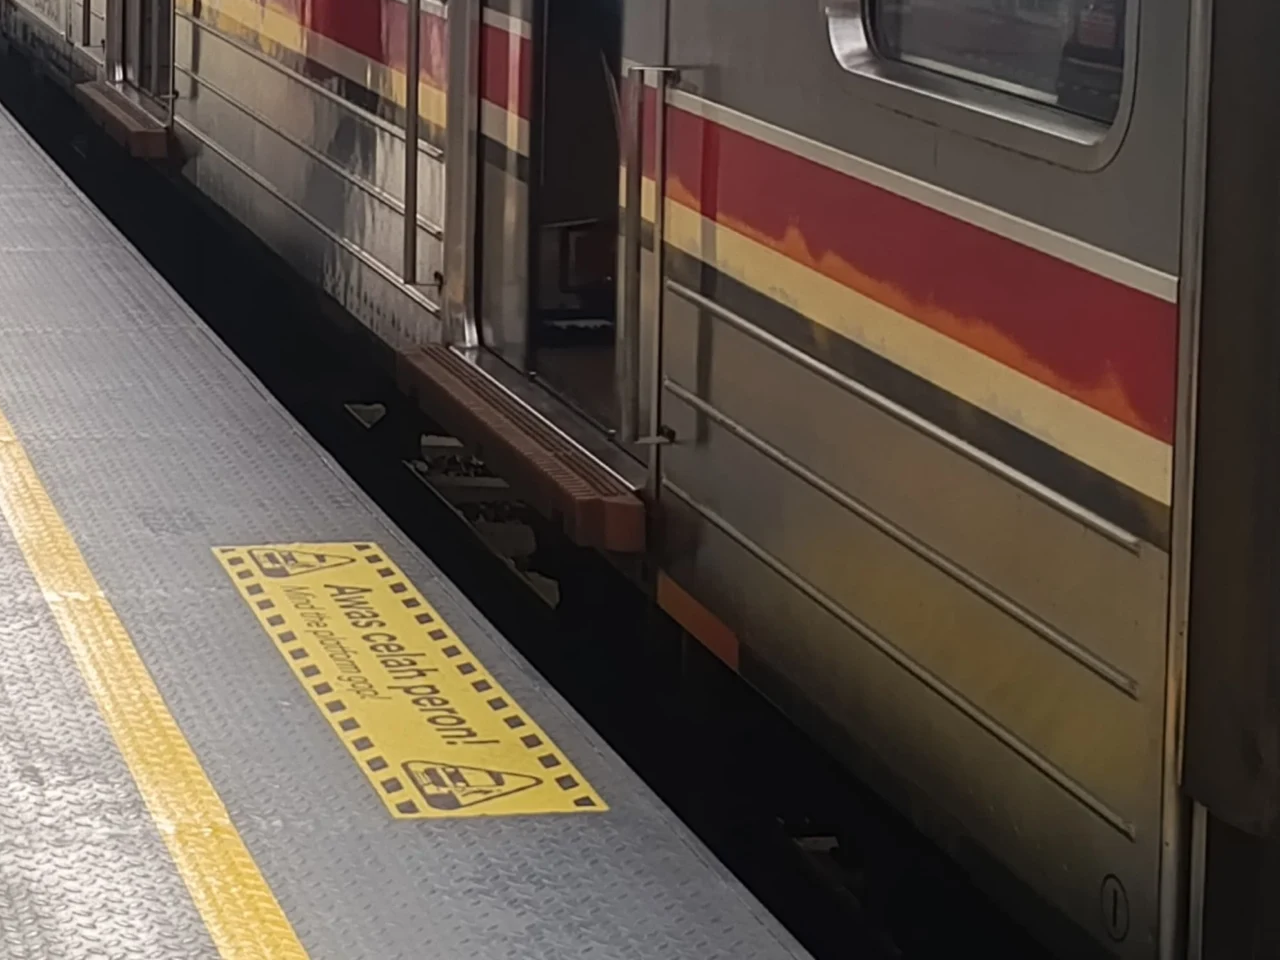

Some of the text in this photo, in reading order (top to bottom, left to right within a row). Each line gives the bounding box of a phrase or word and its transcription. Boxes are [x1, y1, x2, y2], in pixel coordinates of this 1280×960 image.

[279, 585, 394, 700] Mind the platform gap!
[323, 583, 501, 745] Awas celah peron!
